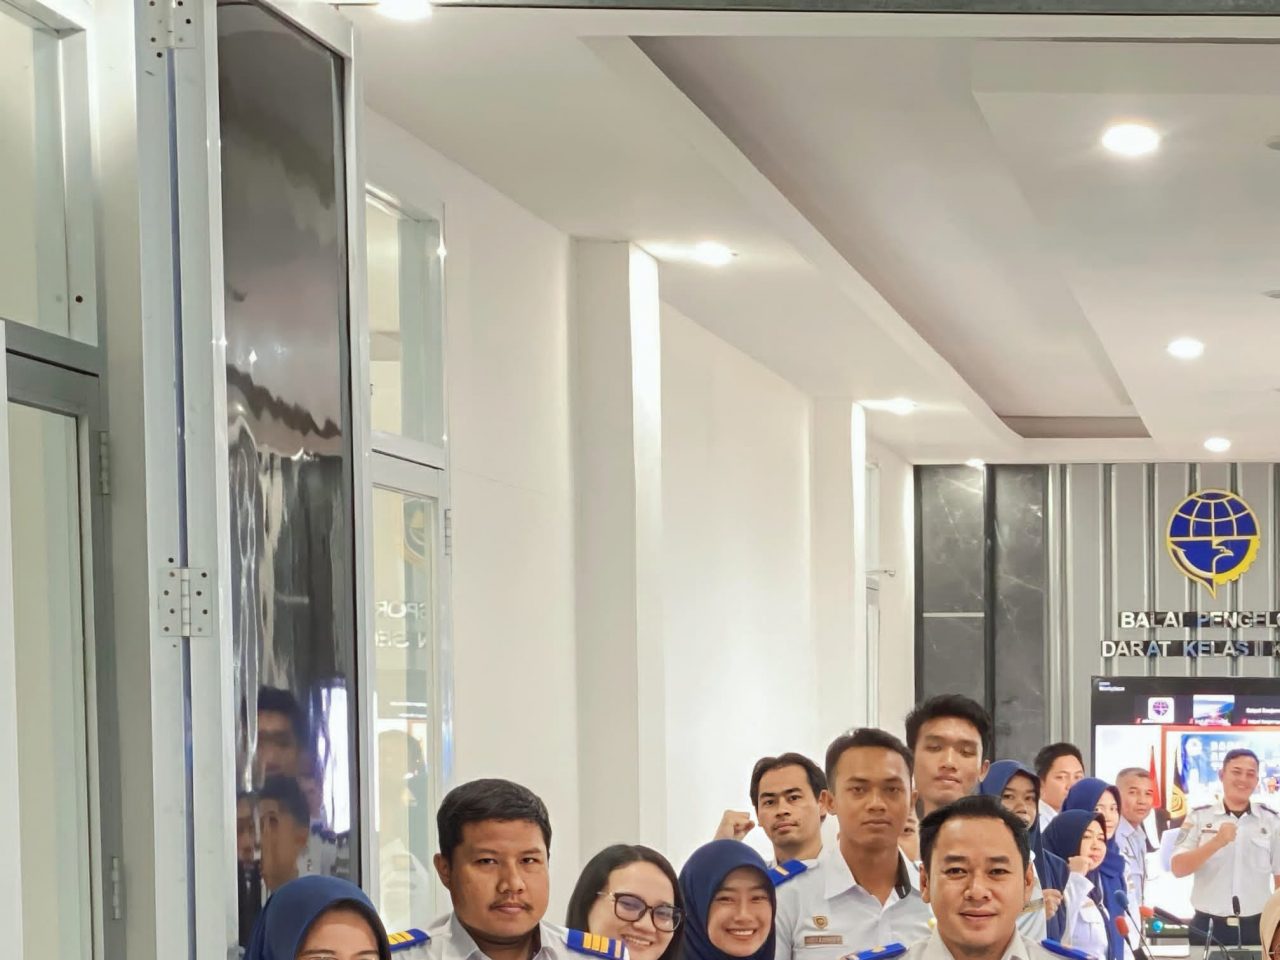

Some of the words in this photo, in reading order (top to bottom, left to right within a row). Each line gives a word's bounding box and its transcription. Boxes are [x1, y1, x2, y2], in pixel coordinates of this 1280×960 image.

[1120, 611, 1184, 628] BALAI
[1102, 640, 1171, 657] DARAT
[1183, 640, 1249, 657] KELAS
